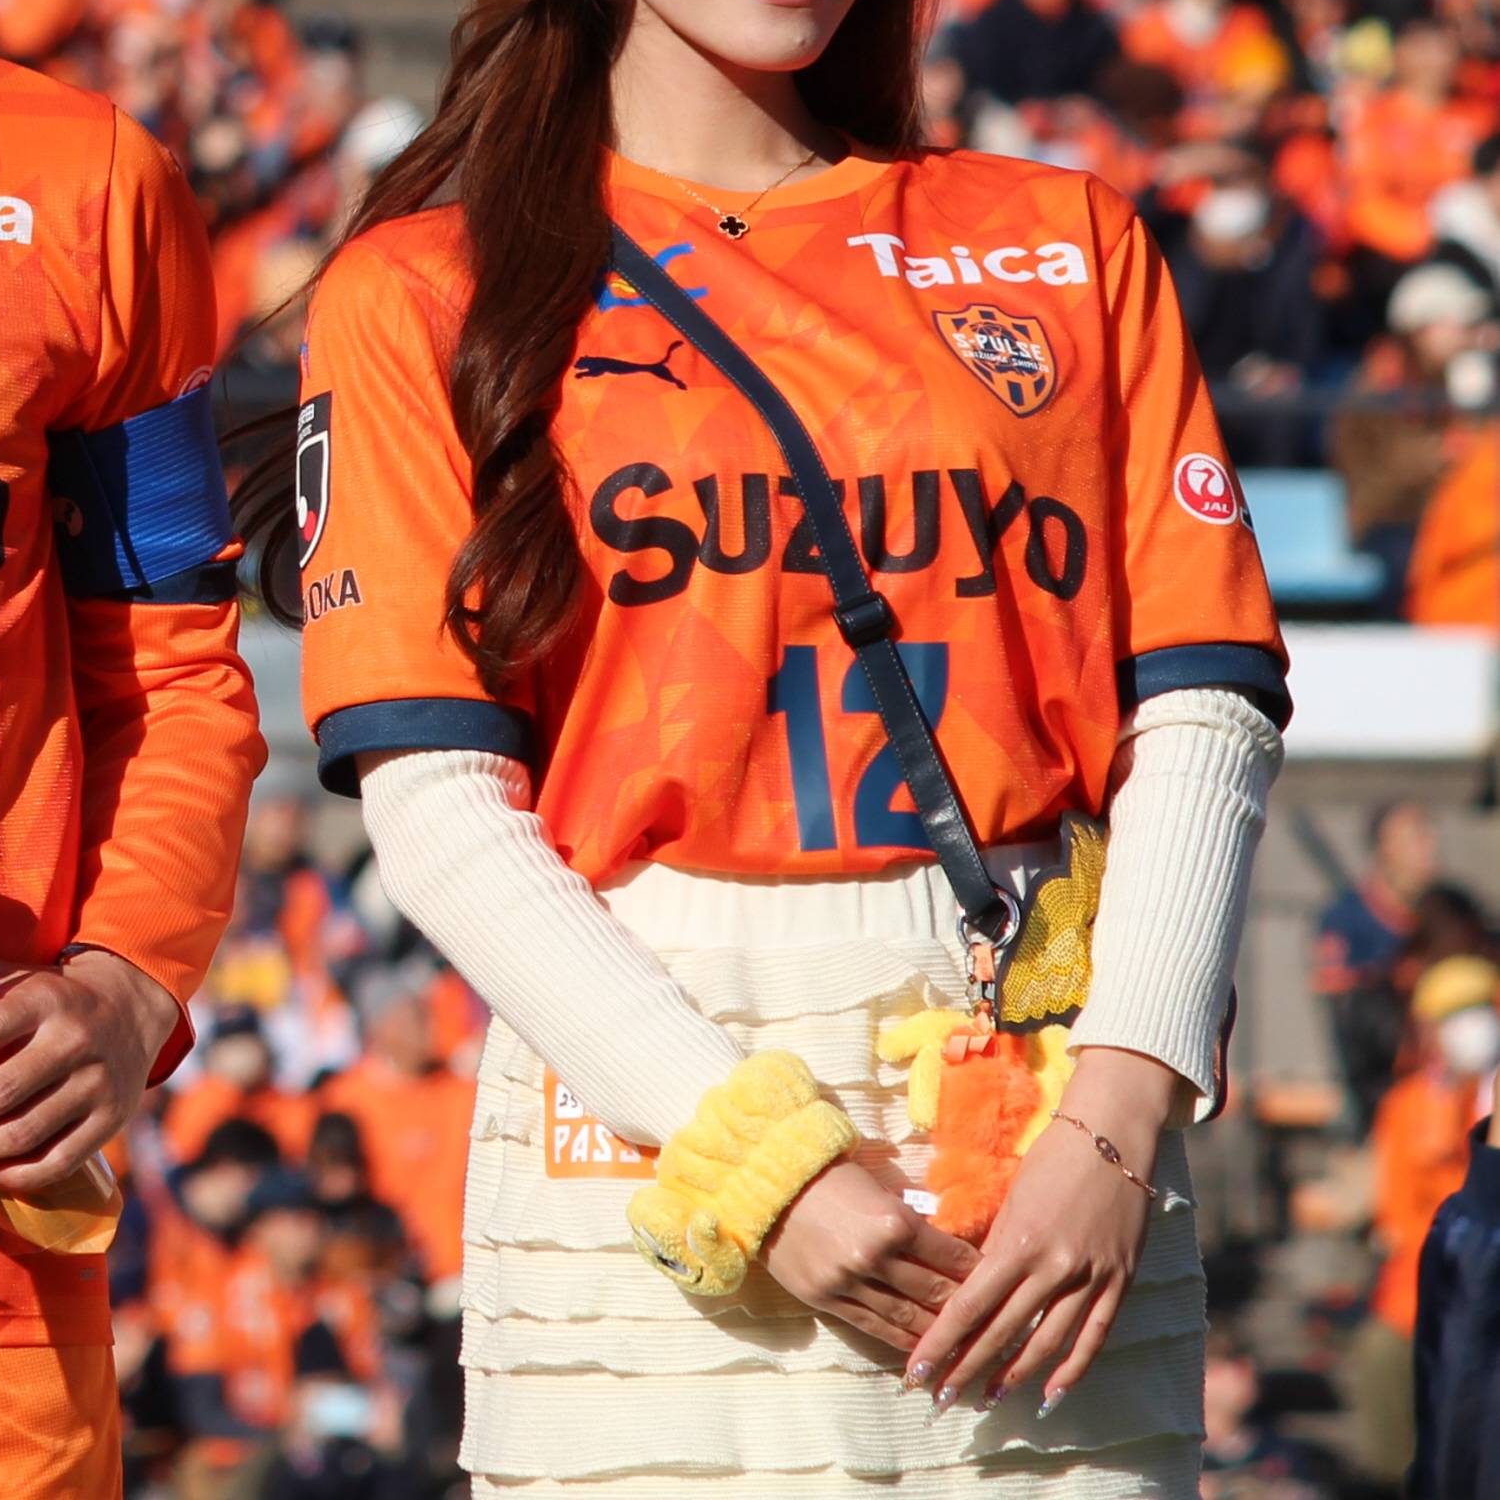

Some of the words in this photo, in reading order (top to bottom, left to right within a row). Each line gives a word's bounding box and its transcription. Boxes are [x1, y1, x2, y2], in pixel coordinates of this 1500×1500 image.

[847, 233, 1089, 288] Taica
[951, 332, 1046, 362] S-PULSE
[1201, 501, 1231, 514] JAL
[766, 641, 949, 852] 12
